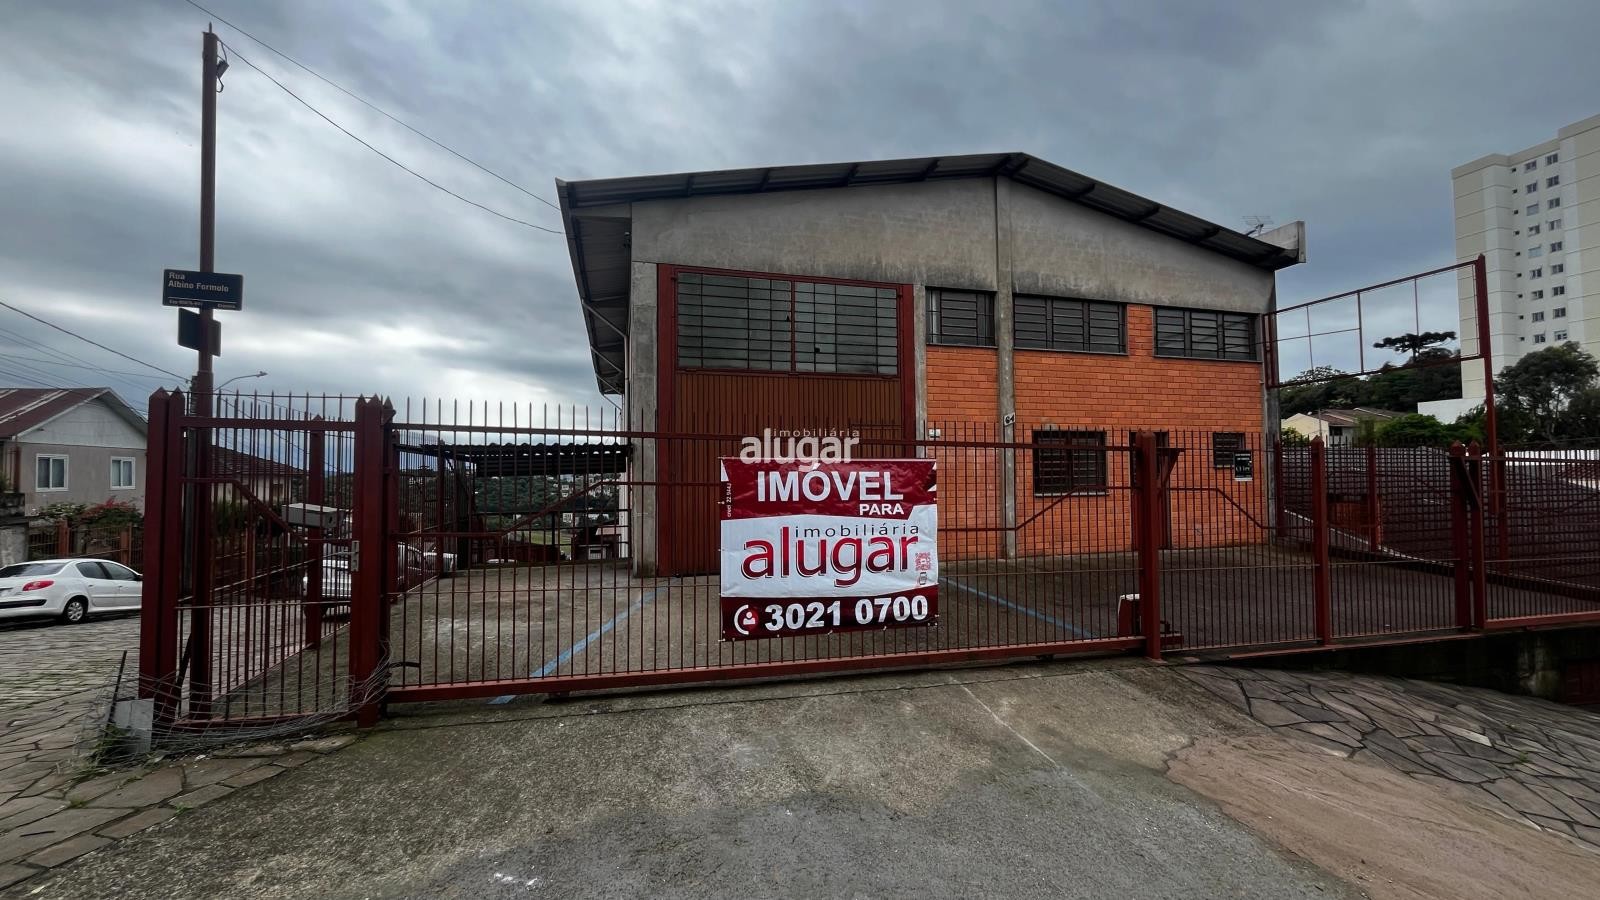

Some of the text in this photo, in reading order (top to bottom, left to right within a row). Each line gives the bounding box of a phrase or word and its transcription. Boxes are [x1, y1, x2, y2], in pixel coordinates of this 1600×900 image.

[168, 272, 186, 280] Rua
[168, 280, 229, 292] Albino Formolo
[757, 463, 904, 502] IMÓVEL
[859, 503, 905, 516] PARA
[795, 523, 919, 538] imobiliária
[741, 526, 919, 587] alugar
[764, 595, 928, 631] 3021 0700
